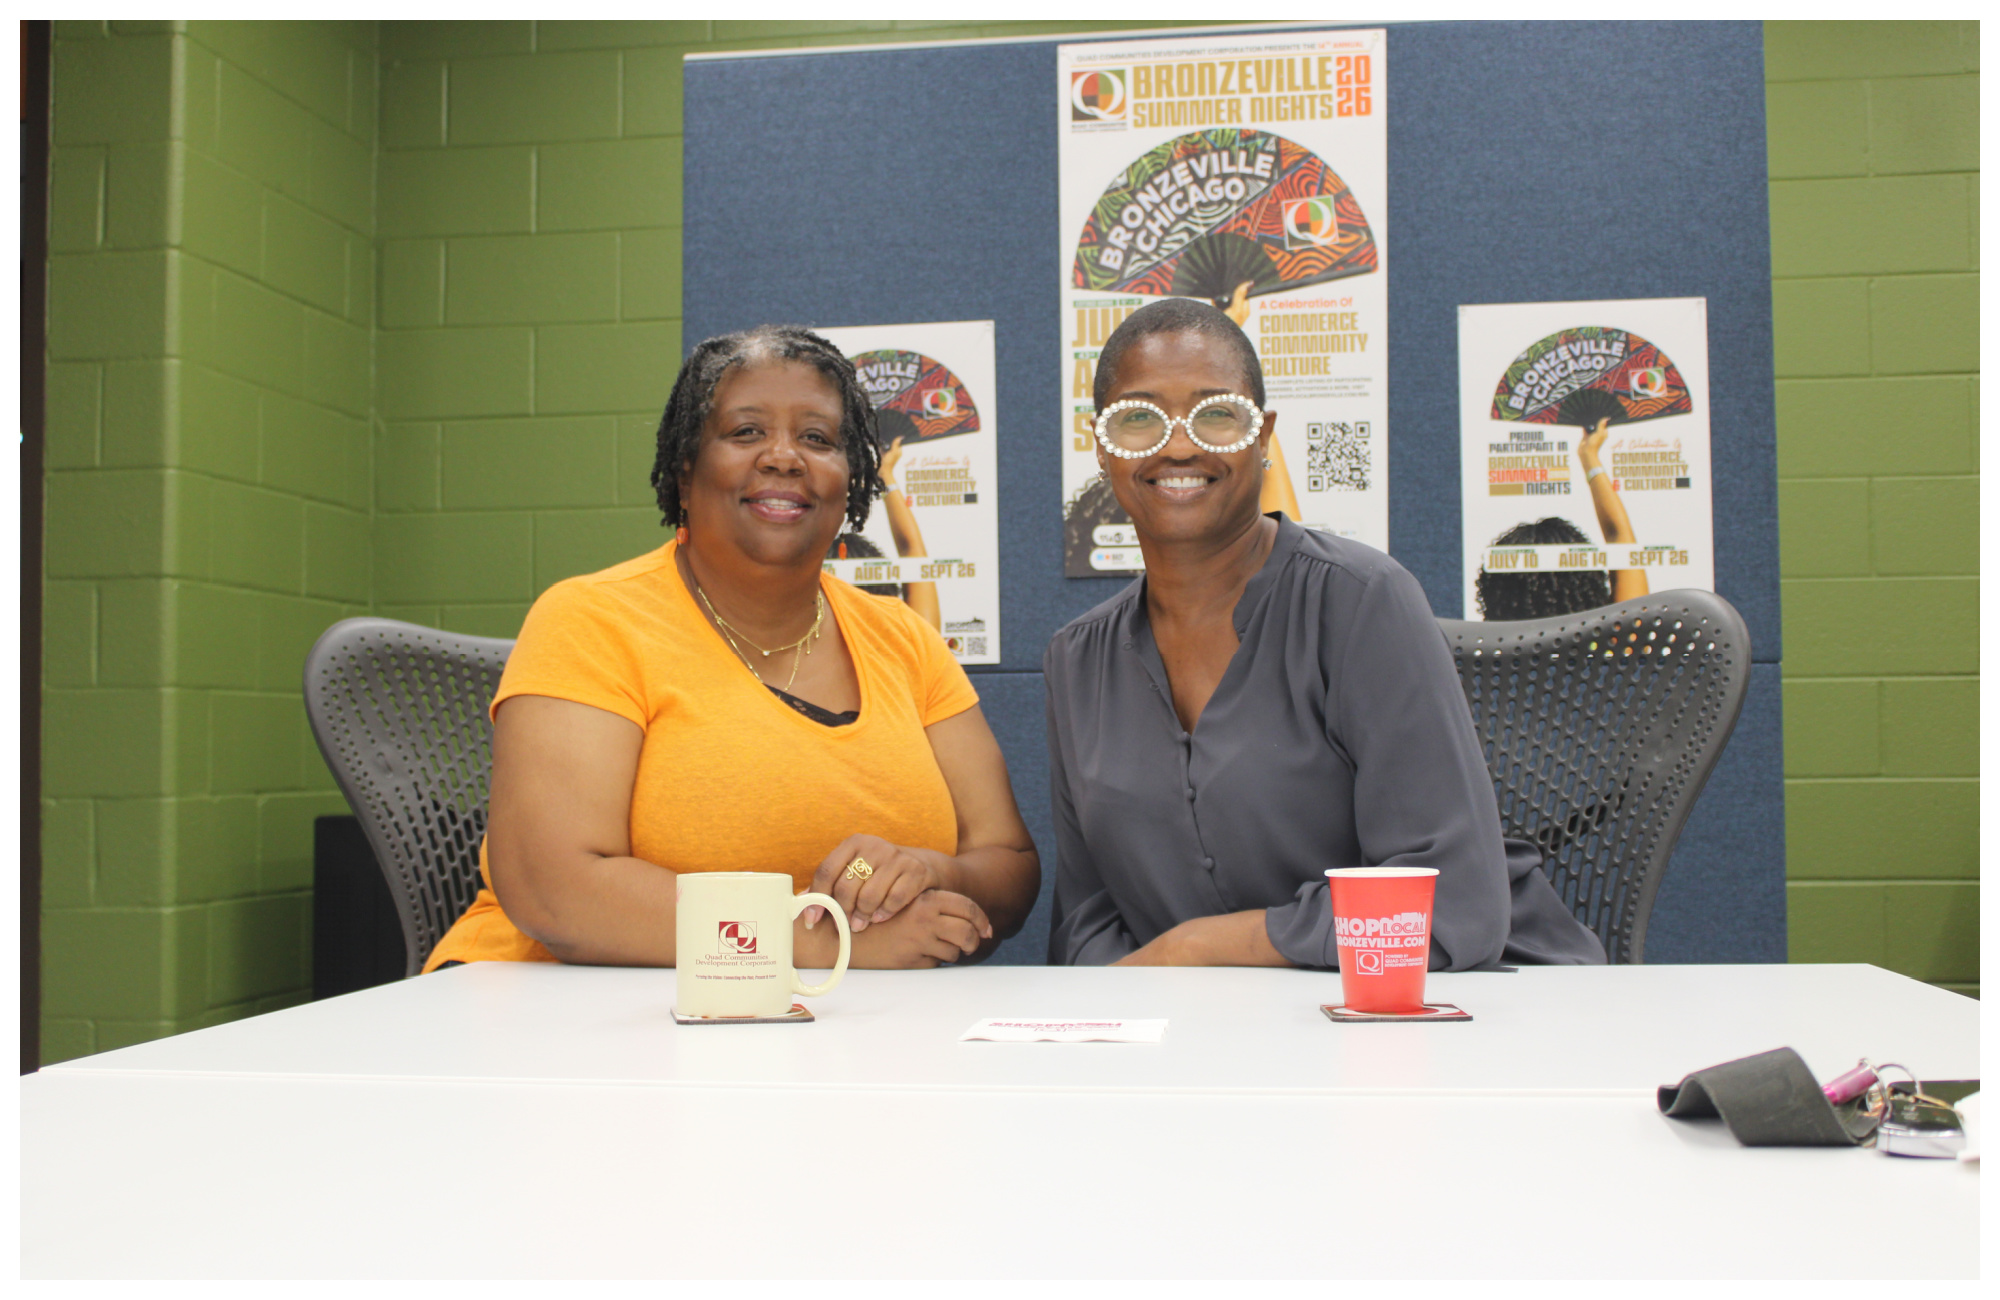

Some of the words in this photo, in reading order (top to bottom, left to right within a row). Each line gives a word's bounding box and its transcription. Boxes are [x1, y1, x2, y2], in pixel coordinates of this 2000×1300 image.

[1133, 56, 1332, 99] BRONZEVILLE
[1336, 55, 1371, 86] 20
[1072, 70, 1127, 121] Q
[1133, 98, 1243, 128] SUMMER
[1251, 93, 1333, 123] NIGHTS
[1337, 87, 1372, 117] 26
[1100, 151, 1275, 270] BRONZEVILLE
[1136, 177, 1245, 253] CHICAGO
[1286, 200, 1336, 244] Q
[1260, 301, 1267, 310] A
[1270, 298, 1337, 309] Celebration
[1340, 297, 1353, 307] Of
[1260, 312, 1358, 334] COMMERCE
[1260, 333, 1368, 355] COMMUNITY
[856, 362, 919, 383] EVILLE
[1261, 356, 1331, 376] CULTURE
[1508, 339, 1625, 410] BRONZEVILLE
[1533, 355, 1605, 398] CHICAGO
[1631, 370, 1665, 397] Q
[924, 389, 955, 417] Q
[1509, 431, 1544, 442] PROUD
[1489, 442, 1554, 454] PARTICIPANT
[1557, 441, 1568, 451] IN
[1488, 455, 1569, 470] BRONZEVILLE
[1612, 464, 1688, 478] COMMUNITY
[1488, 469, 1548, 484] SUMMER
[1624, 478, 1674, 491] CULTURE
[906, 481, 976, 494] COMMUNITY
[1526, 482, 1571, 495] NIGHTS
[916, 494, 963, 507] CULTURE
[1487, 554, 1518, 569] JULY
[1524, 554, 1538, 568] 10
[1559, 553, 1587, 568] AUG
[1592, 552, 1607, 567] 14
[1629, 551, 1663, 566] SEPT
[1669, 550, 1689, 565] 26
[854, 566, 882, 581] AUG
[887, 565, 900, 580] 14
[921, 564, 953, 579] SEPT
[958, 563, 975, 578] 26
[719, 922, 756, 953] Q
[696, 959, 738, 967] Development
[1359, 953, 1380, 972] Q
